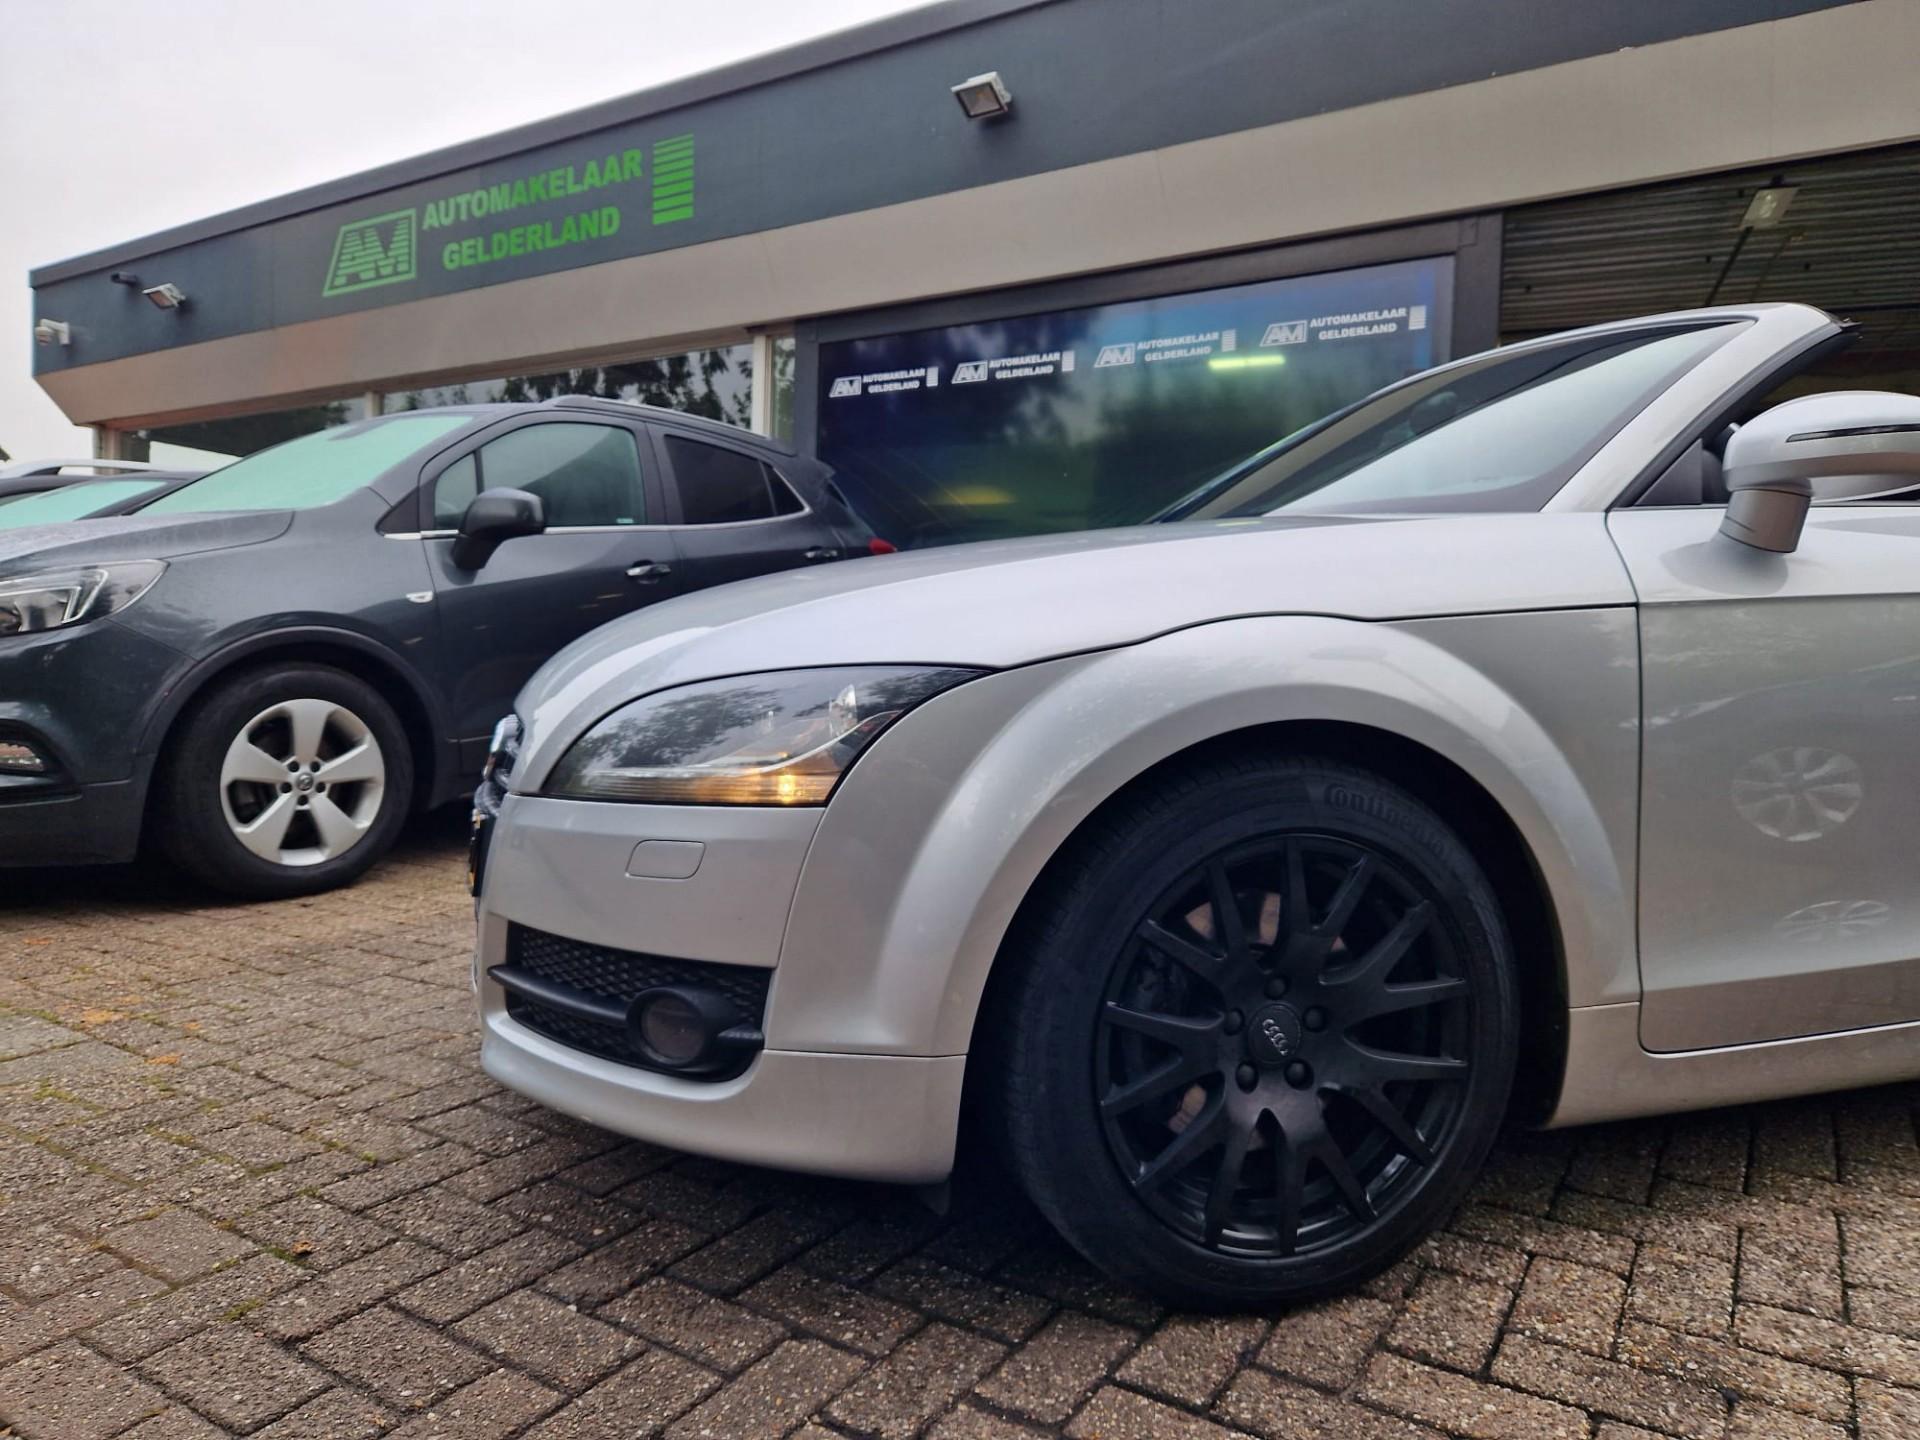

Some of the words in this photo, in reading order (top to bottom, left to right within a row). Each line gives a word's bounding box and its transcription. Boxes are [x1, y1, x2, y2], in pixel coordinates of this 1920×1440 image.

[422, 149, 643, 230] AUTOMAKELAAR
[442, 207, 620, 270] GELDERLAND
[333, 218, 410, 286] AM
[1310, 308, 1407, 329] AUTOMAKELAAR
[1271, 326, 1304, 344] AM
[1319, 323, 1397, 341] GELDERLAND
[1137, 332, 1219, 350] AUTOMAKELAAR
[989, 353, 1060, 369] AUTOMAKELAAR
[1100, 348, 1134, 365] AM
[1145, 346, 1212, 362] GELDERLAND
[863, 369, 926, 384] AUTOMAKELAAR
[957, 366, 986, 382] AM
[996, 365, 1053, 380] GELDERLAND
[837, 380, 862, 395] AM
[868, 381, 920, 394] GELDERLAND
